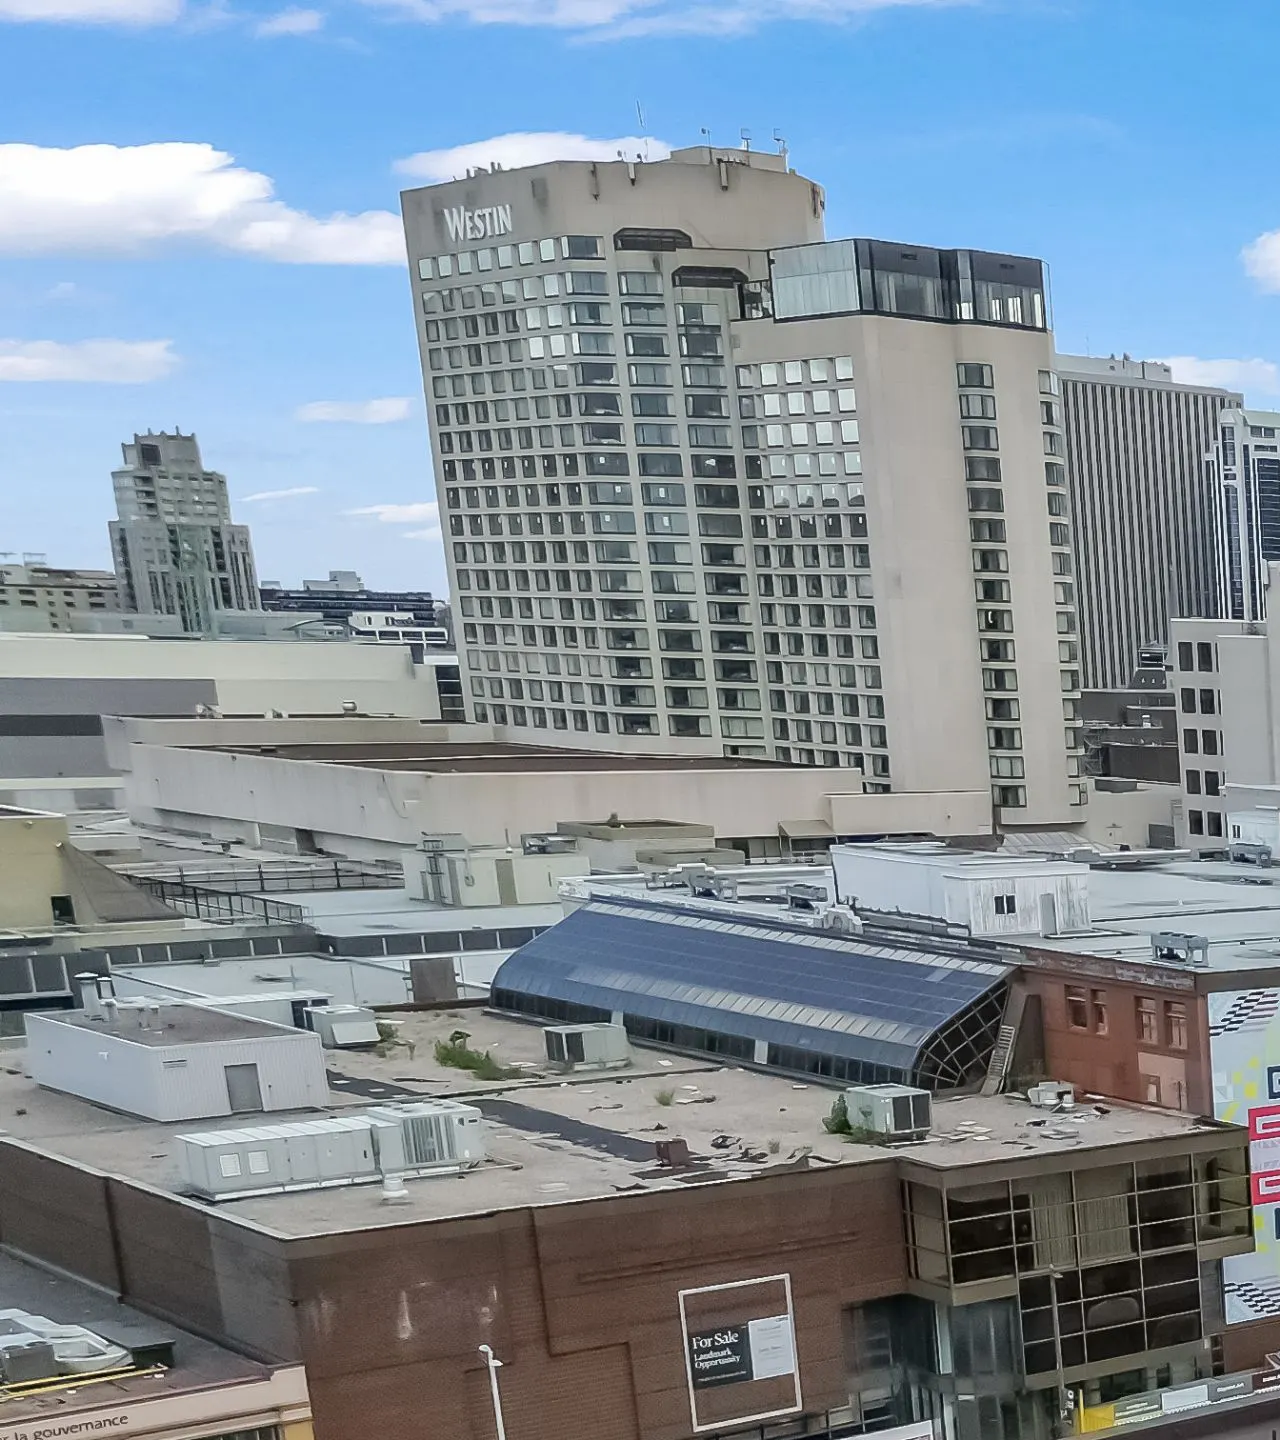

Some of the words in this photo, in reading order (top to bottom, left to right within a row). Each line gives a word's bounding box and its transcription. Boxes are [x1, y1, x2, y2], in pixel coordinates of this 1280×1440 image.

[444, 204, 512, 242] WESTIN
[692, 1337, 713, 1350] For
[714, 1330, 739, 1347] Sale
